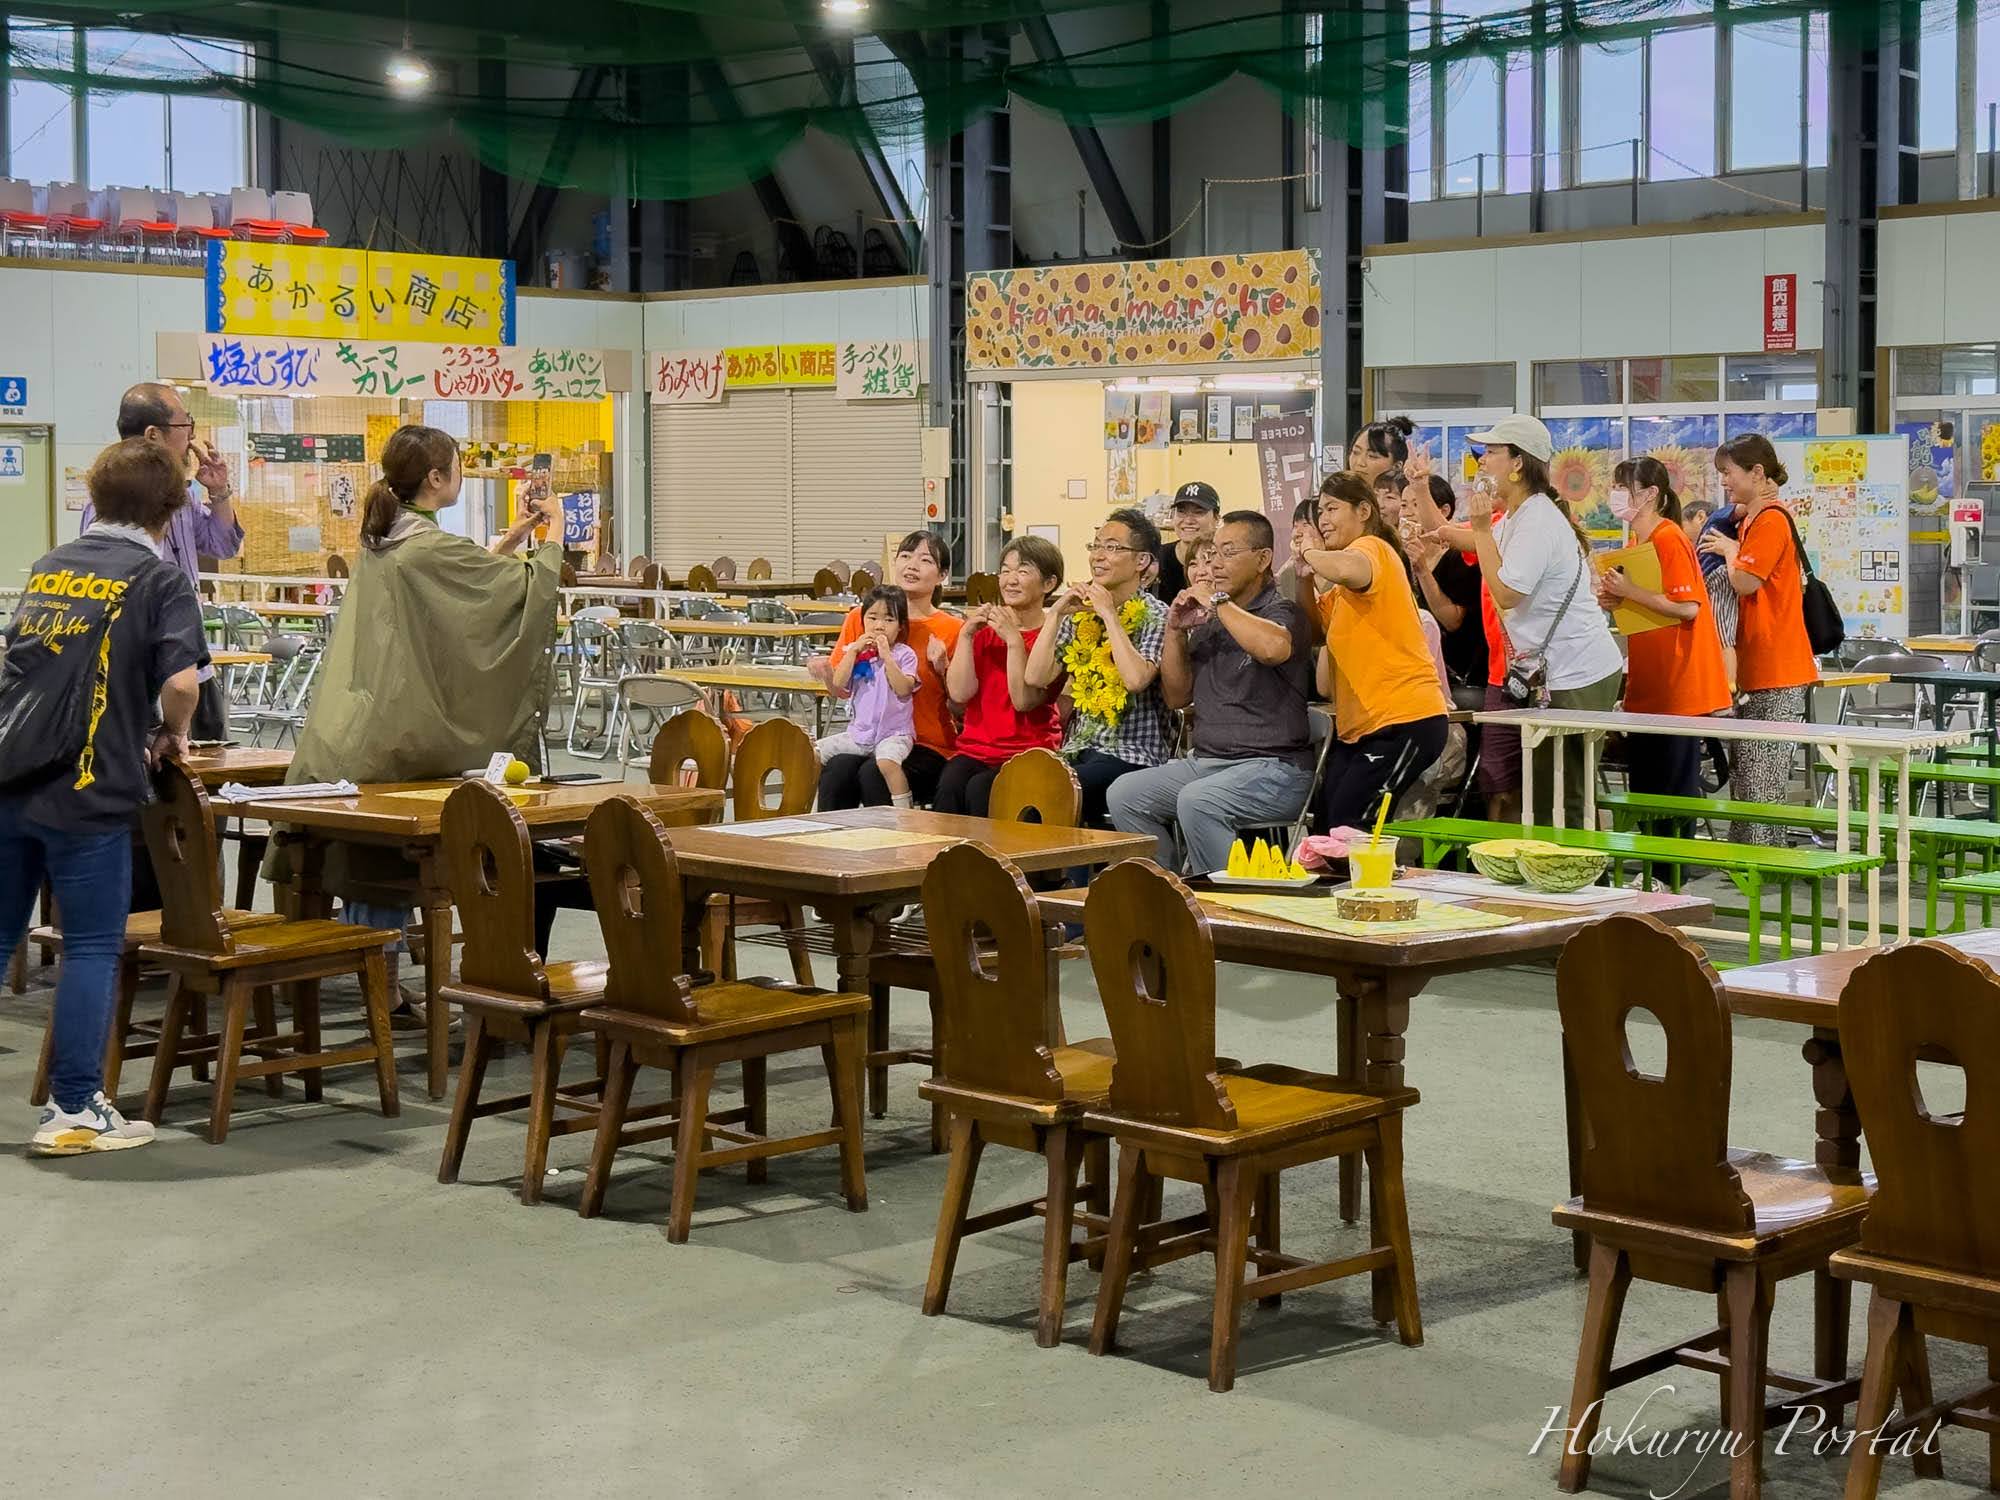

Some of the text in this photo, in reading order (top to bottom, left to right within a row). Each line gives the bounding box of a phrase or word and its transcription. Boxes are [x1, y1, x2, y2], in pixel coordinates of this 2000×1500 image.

[248, 263, 480, 330] あかるい商店
[1008, 284, 1287, 327] hana marche
[1771, 278, 1788, 332] 館内禁煙
[208, 339, 320, 390] 塩むすび
[336, 342, 398, 371] キーマ
[442, 346, 500, 367] ころころ
[528, 347, 602, 375] あげパン
[727, 349, 836, 379] あかるい商店
[841, 343, 902, 374] 手づくり
[352, 369, 426, 395] カレー
[434, 367, 524, 398] じゃがバター
[532, 376, 606, 399] チュロス
[657, 350, 725, 399] おみやげ
[862, 363, 915, 397] 雑貨
[26, 569, 129, 602] adidas
